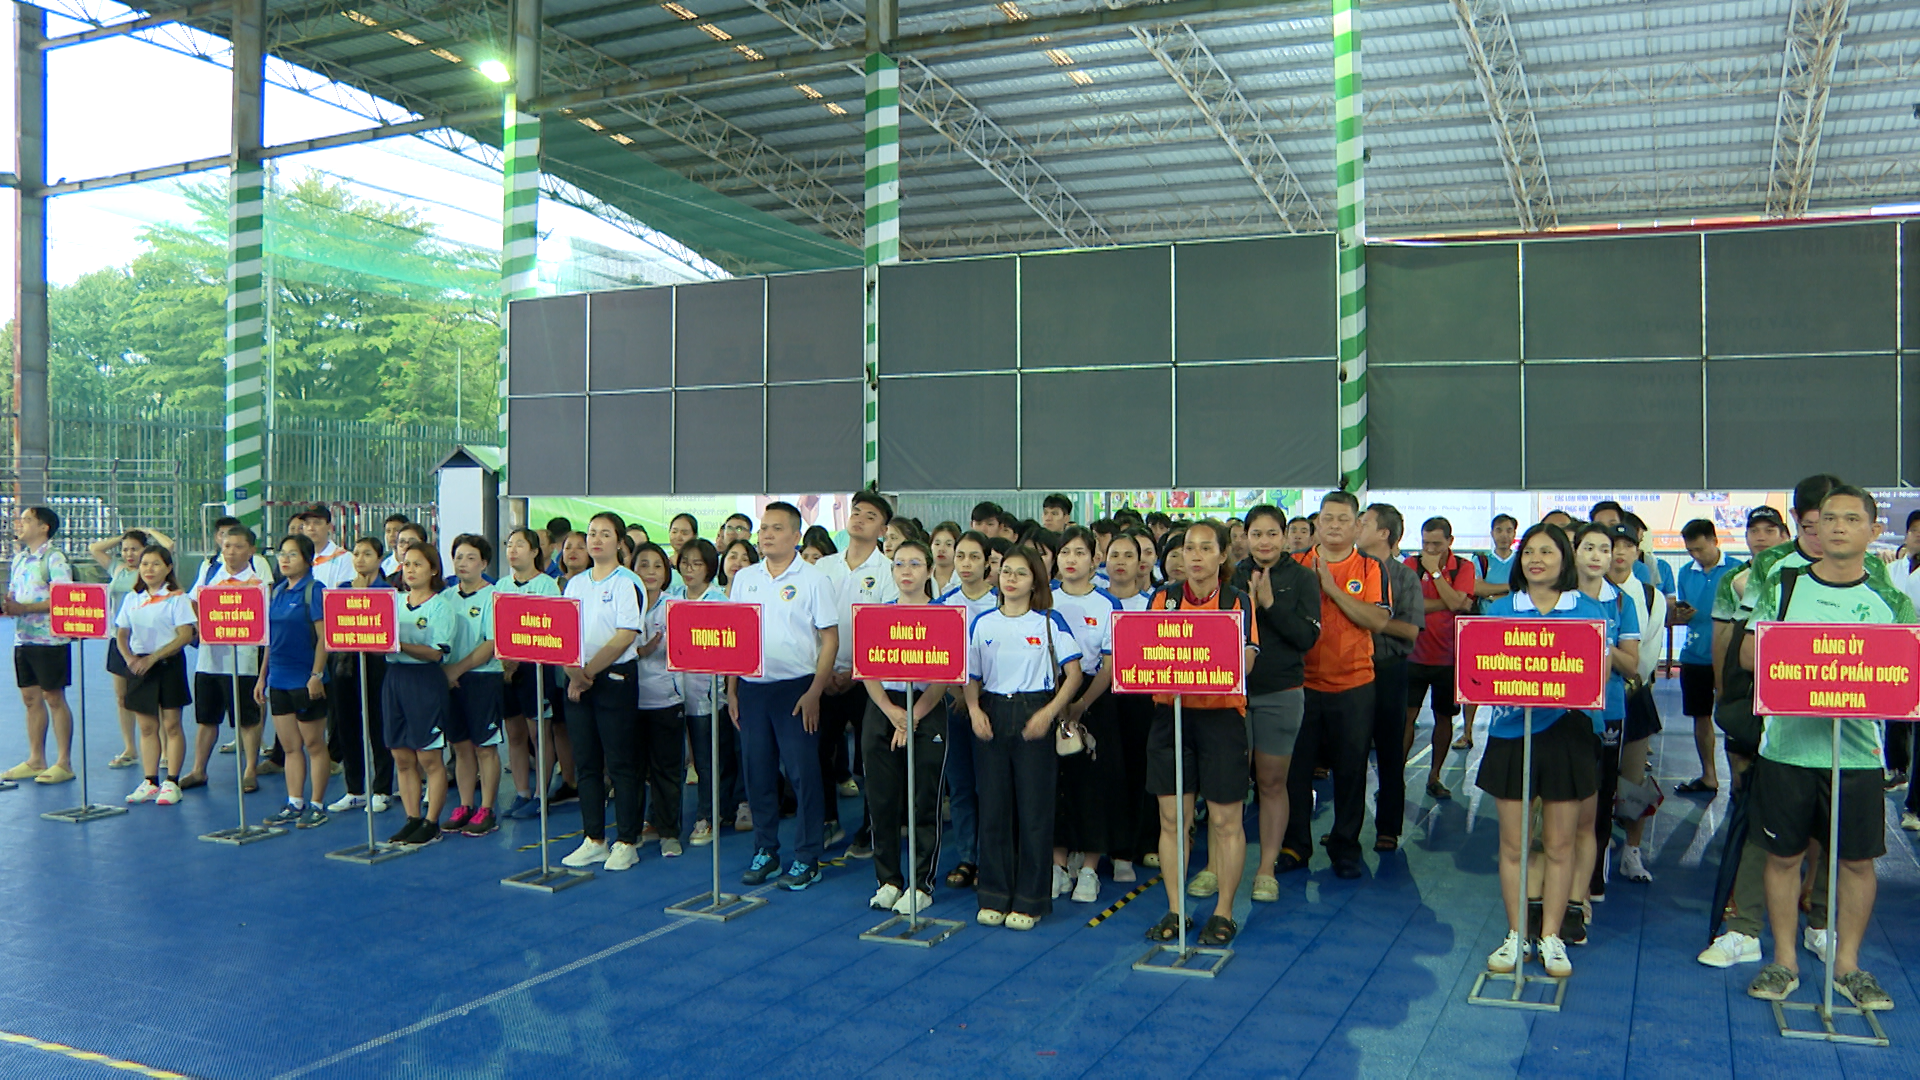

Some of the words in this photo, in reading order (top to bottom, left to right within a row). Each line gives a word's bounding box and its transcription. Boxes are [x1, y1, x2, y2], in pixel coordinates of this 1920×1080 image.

[520, 612, 541, 628] ĐẢNG
[542, 613, 552, 629] ỦY
[890, 621, 914, 640] ĐẢNG
[915, 621, 927, 640] ỦY
[1157, 619, 1180, 638] ĐẢNG
[1182, 619, 1194, 638] ỦY
[511, 632, 531, 646] UBND
[691, 628, 720, 650] TRỌNG
[721, 626, 736, 648] TÀI
[1504, 627, 1537, 646] ĐẢNG
[1539, 627, 1555, 648] ỦY
[1813, 633, 1846, 654] ĐẢNG
[1848, 633, 1865, 655] ỦY
[868, 645, 886, 663] CÁC
[887, 648, 900, 663] CƠ
[901, 649, 924, 665] QUAN
[925, 645, 949, 665] ĐẢNG
[1142, 643, 1175, 661] TRƯỜNG
[1177, 647, 1191, 664] ĐẠI
[1193, 647, 1210, 664] HỌC
[1476, 652, 1522, 671] TRƯỜNG
[1524, 657, 1548, 672] CAO
[1550, 651, 1584, 673] ĐẲNG
[1121, 664, 1137, 684] THỂ
[1138, 670, 1155, 687] DỤC
[1156, 665, 1172, 684] THỂ
[1173, 671, 1195, 685] THAO
[1196, 668, 1208, 685] ĐÀ
[1209, 666, 1234, 686] NẴNG
[1769, 661, 1802, 680] CÔNG
[1804, 665, 1819, 680] TY
[1821, 659, 1838, 681] CỔ
[1876, 665, 1909, 686] DƯỢC
[1493, 680, 1539, 696] THƯƠNG
[1542, 682, 1566, 700] MẠI
[1809, 691, 1866, 708] DANAPHA
